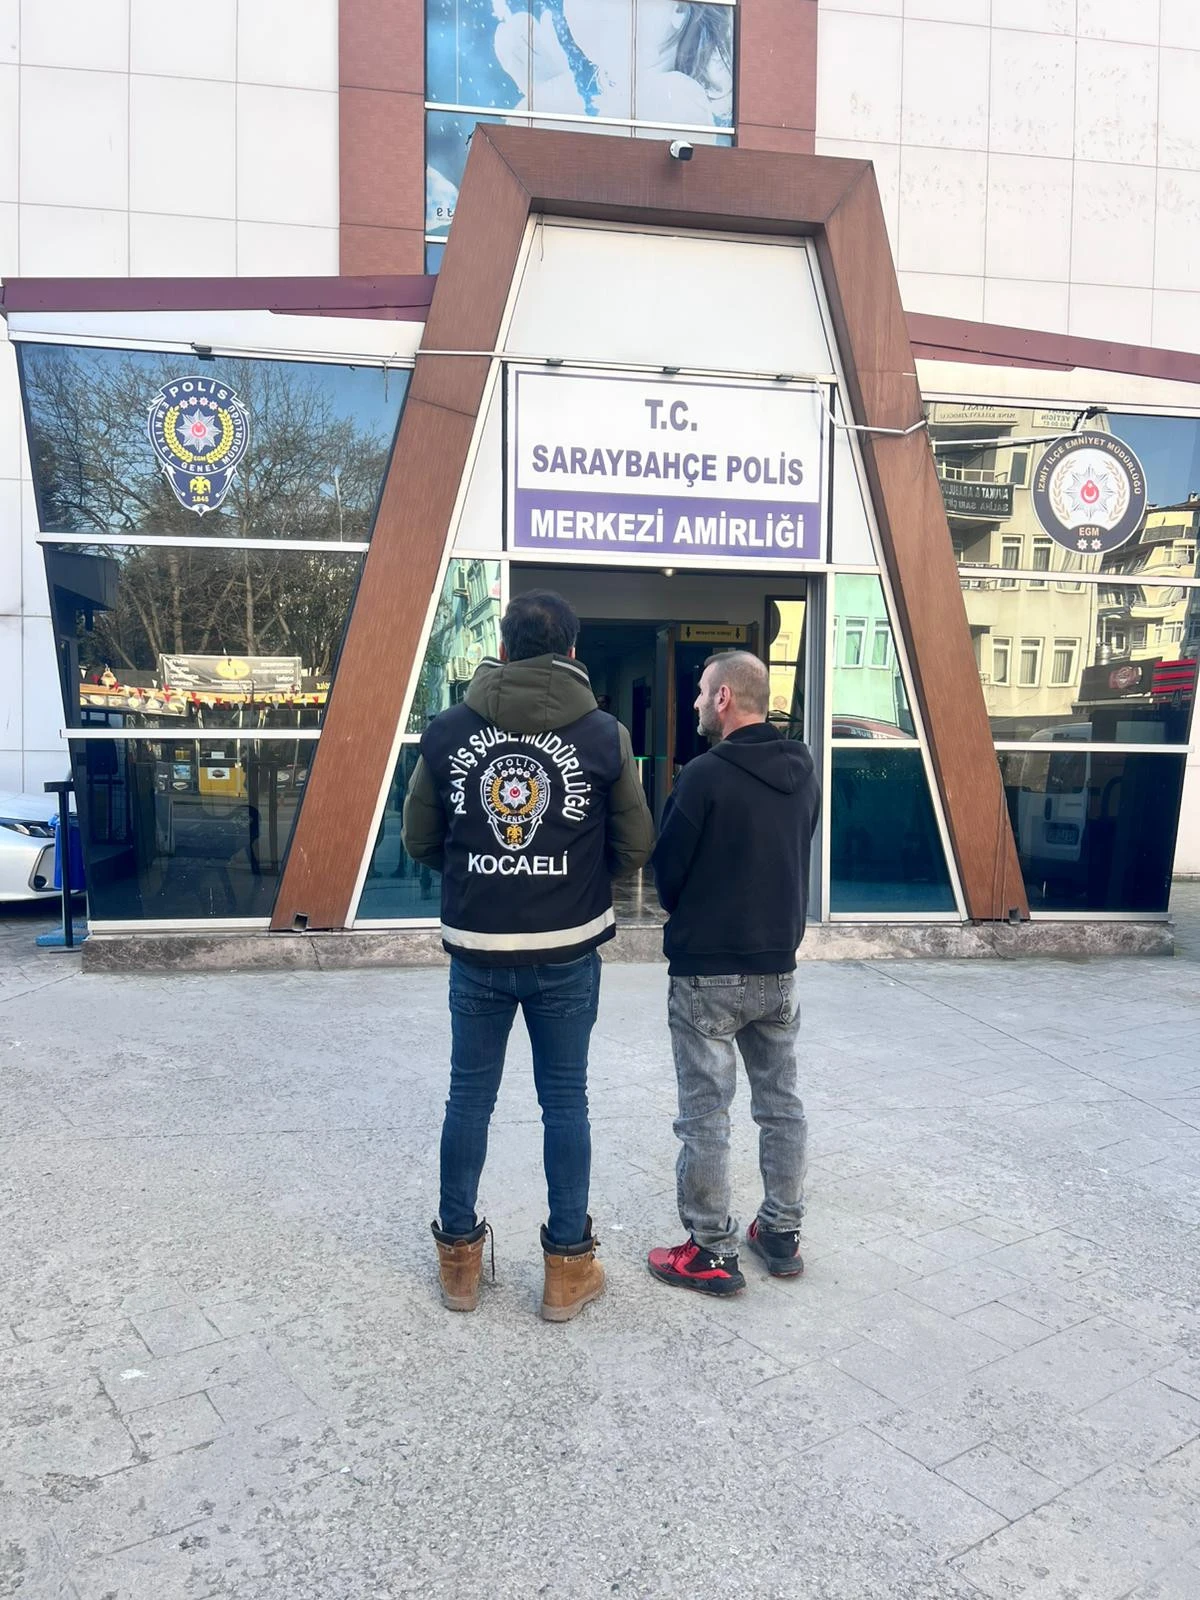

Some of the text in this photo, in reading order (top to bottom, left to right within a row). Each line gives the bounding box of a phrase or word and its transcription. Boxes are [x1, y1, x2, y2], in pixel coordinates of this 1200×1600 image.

[169, 381, 228, 400] POLİS
[644, 398, 698, 431] T.C.
[155, 401, 175, 459] EMNİYET
[181, 461, 218, 472] GENEL
[532, 444, 804, 488] SARAYBAHÇE POLİS
[1036, 436, 1142, 495] İZMİT İLÇE EMNİYET MÜDÜRLÜĞÜ
[530, 508, 804, 549] MERKEZİ AMİRLİĞİ
[1078, 527, 1100, 537] EGM
[448, 747, 479, 815] ASAYİŞ
[496, 758, 536, 772] POLİS
[467, 850, 569, 876] KOCAELİ
